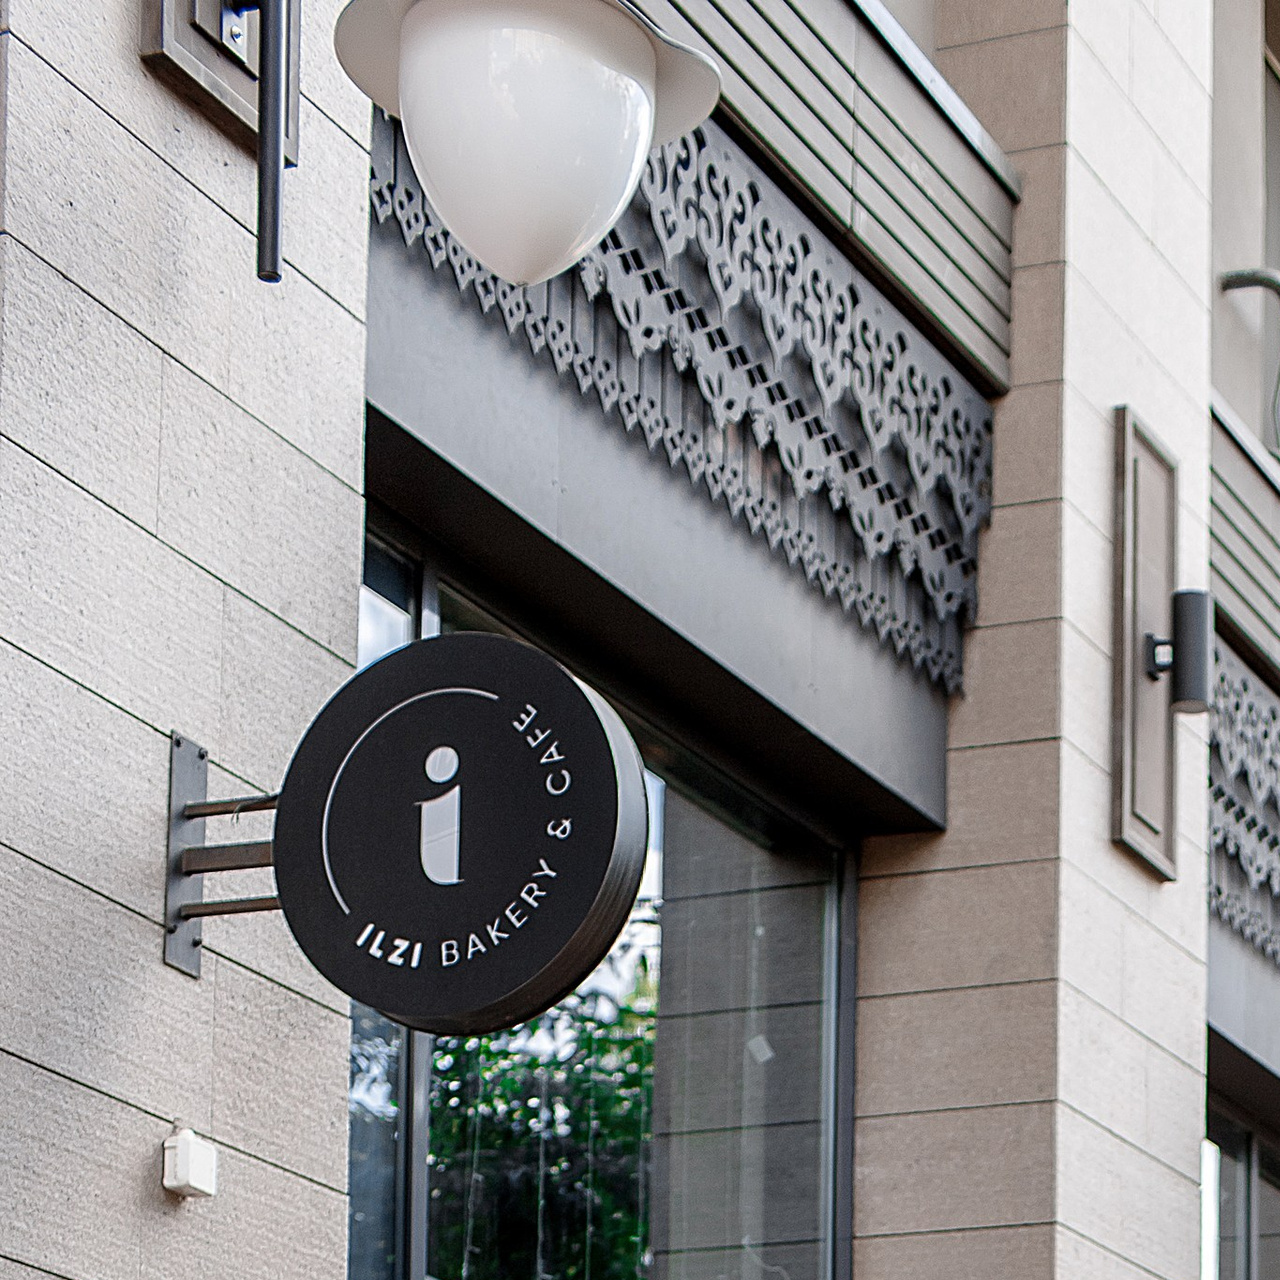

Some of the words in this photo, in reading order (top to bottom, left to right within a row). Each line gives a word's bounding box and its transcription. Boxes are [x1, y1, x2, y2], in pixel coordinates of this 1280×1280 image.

[511, 703, 573, 796] CAFE
[546, 818, 572, 840] &
[355, 923, 423, 969] ILZI
[441, 857, 558, 967] BAKERY
